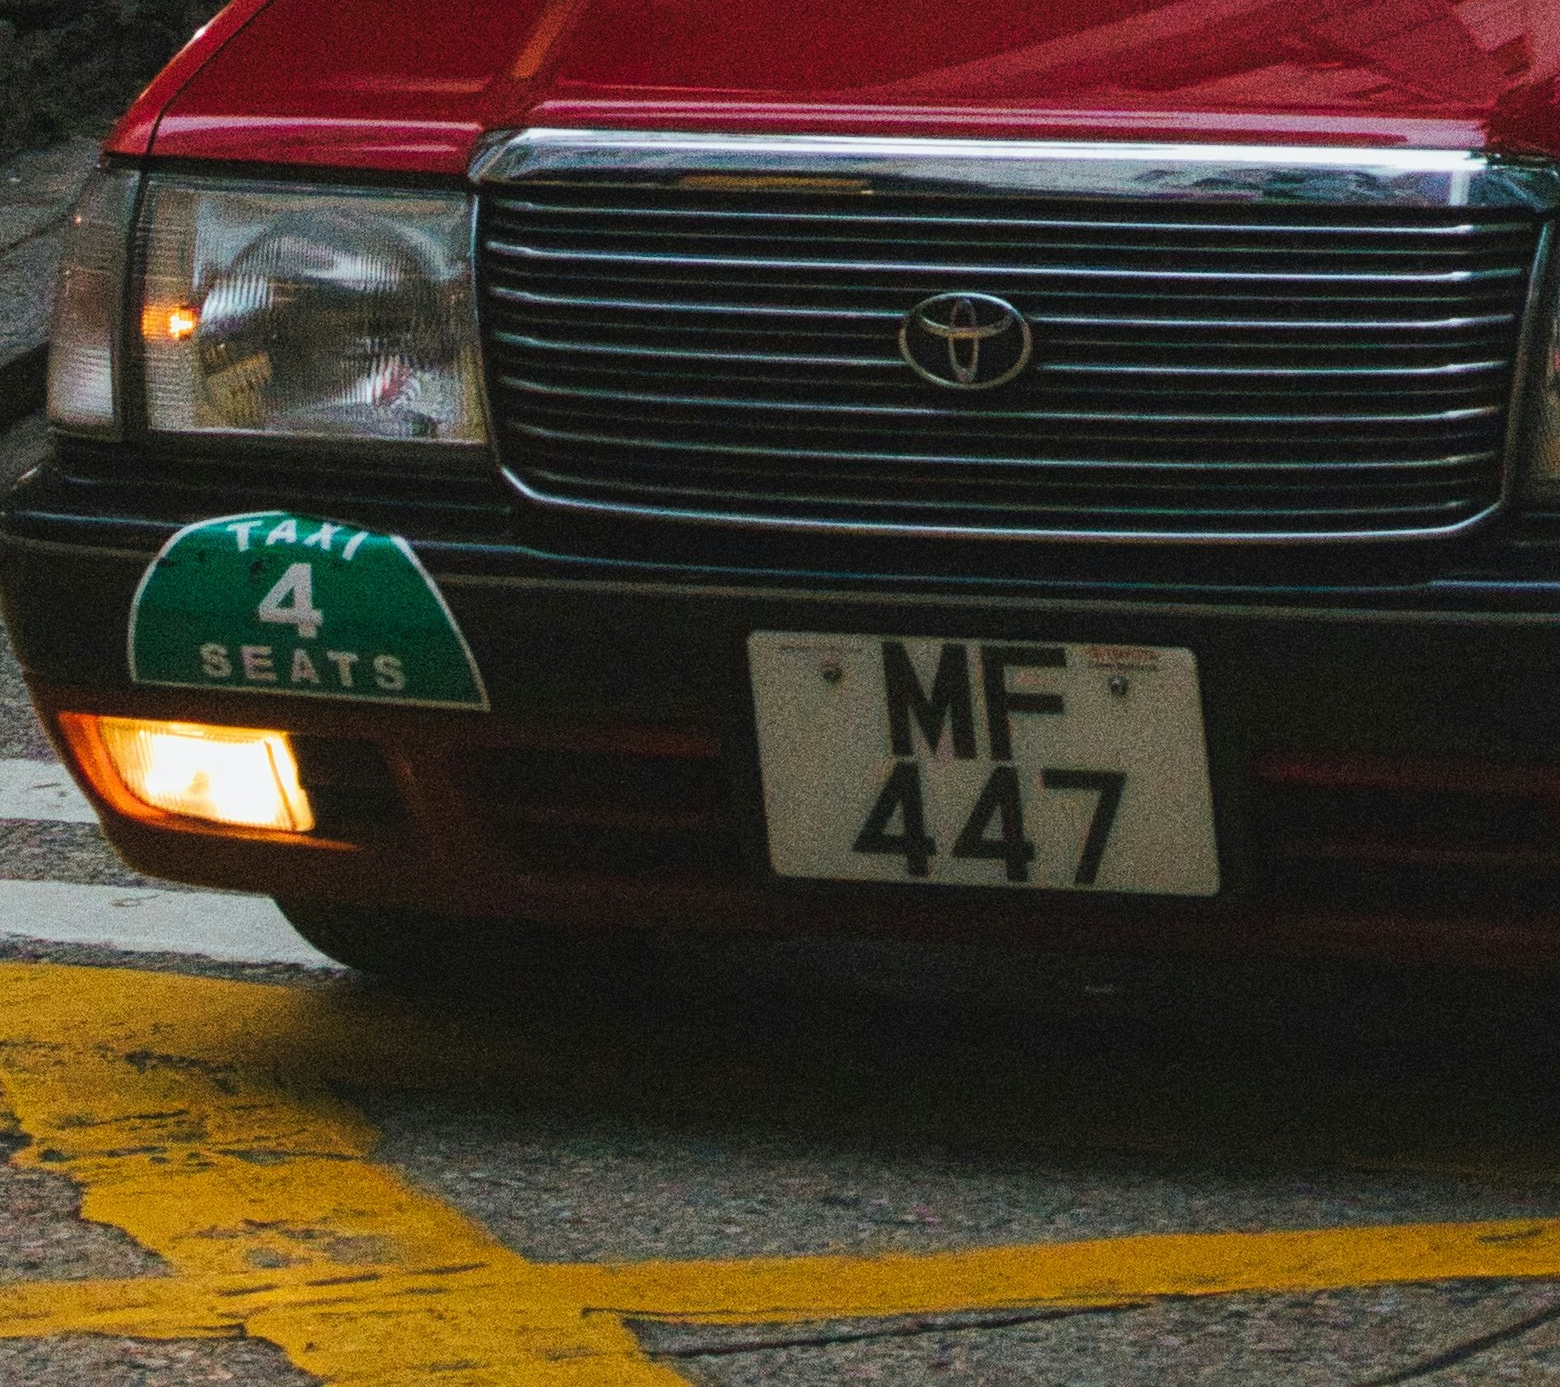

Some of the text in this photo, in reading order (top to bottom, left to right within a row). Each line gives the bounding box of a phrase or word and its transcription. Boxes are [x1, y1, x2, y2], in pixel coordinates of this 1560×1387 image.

[226, 517, 369, 563] TAXI
[257, 561, 324, 640] 4
[199, 643, 406, 691] SEATS
[880, 641, 1067, 761] MF
[851, 760, 1128, 885] 447
